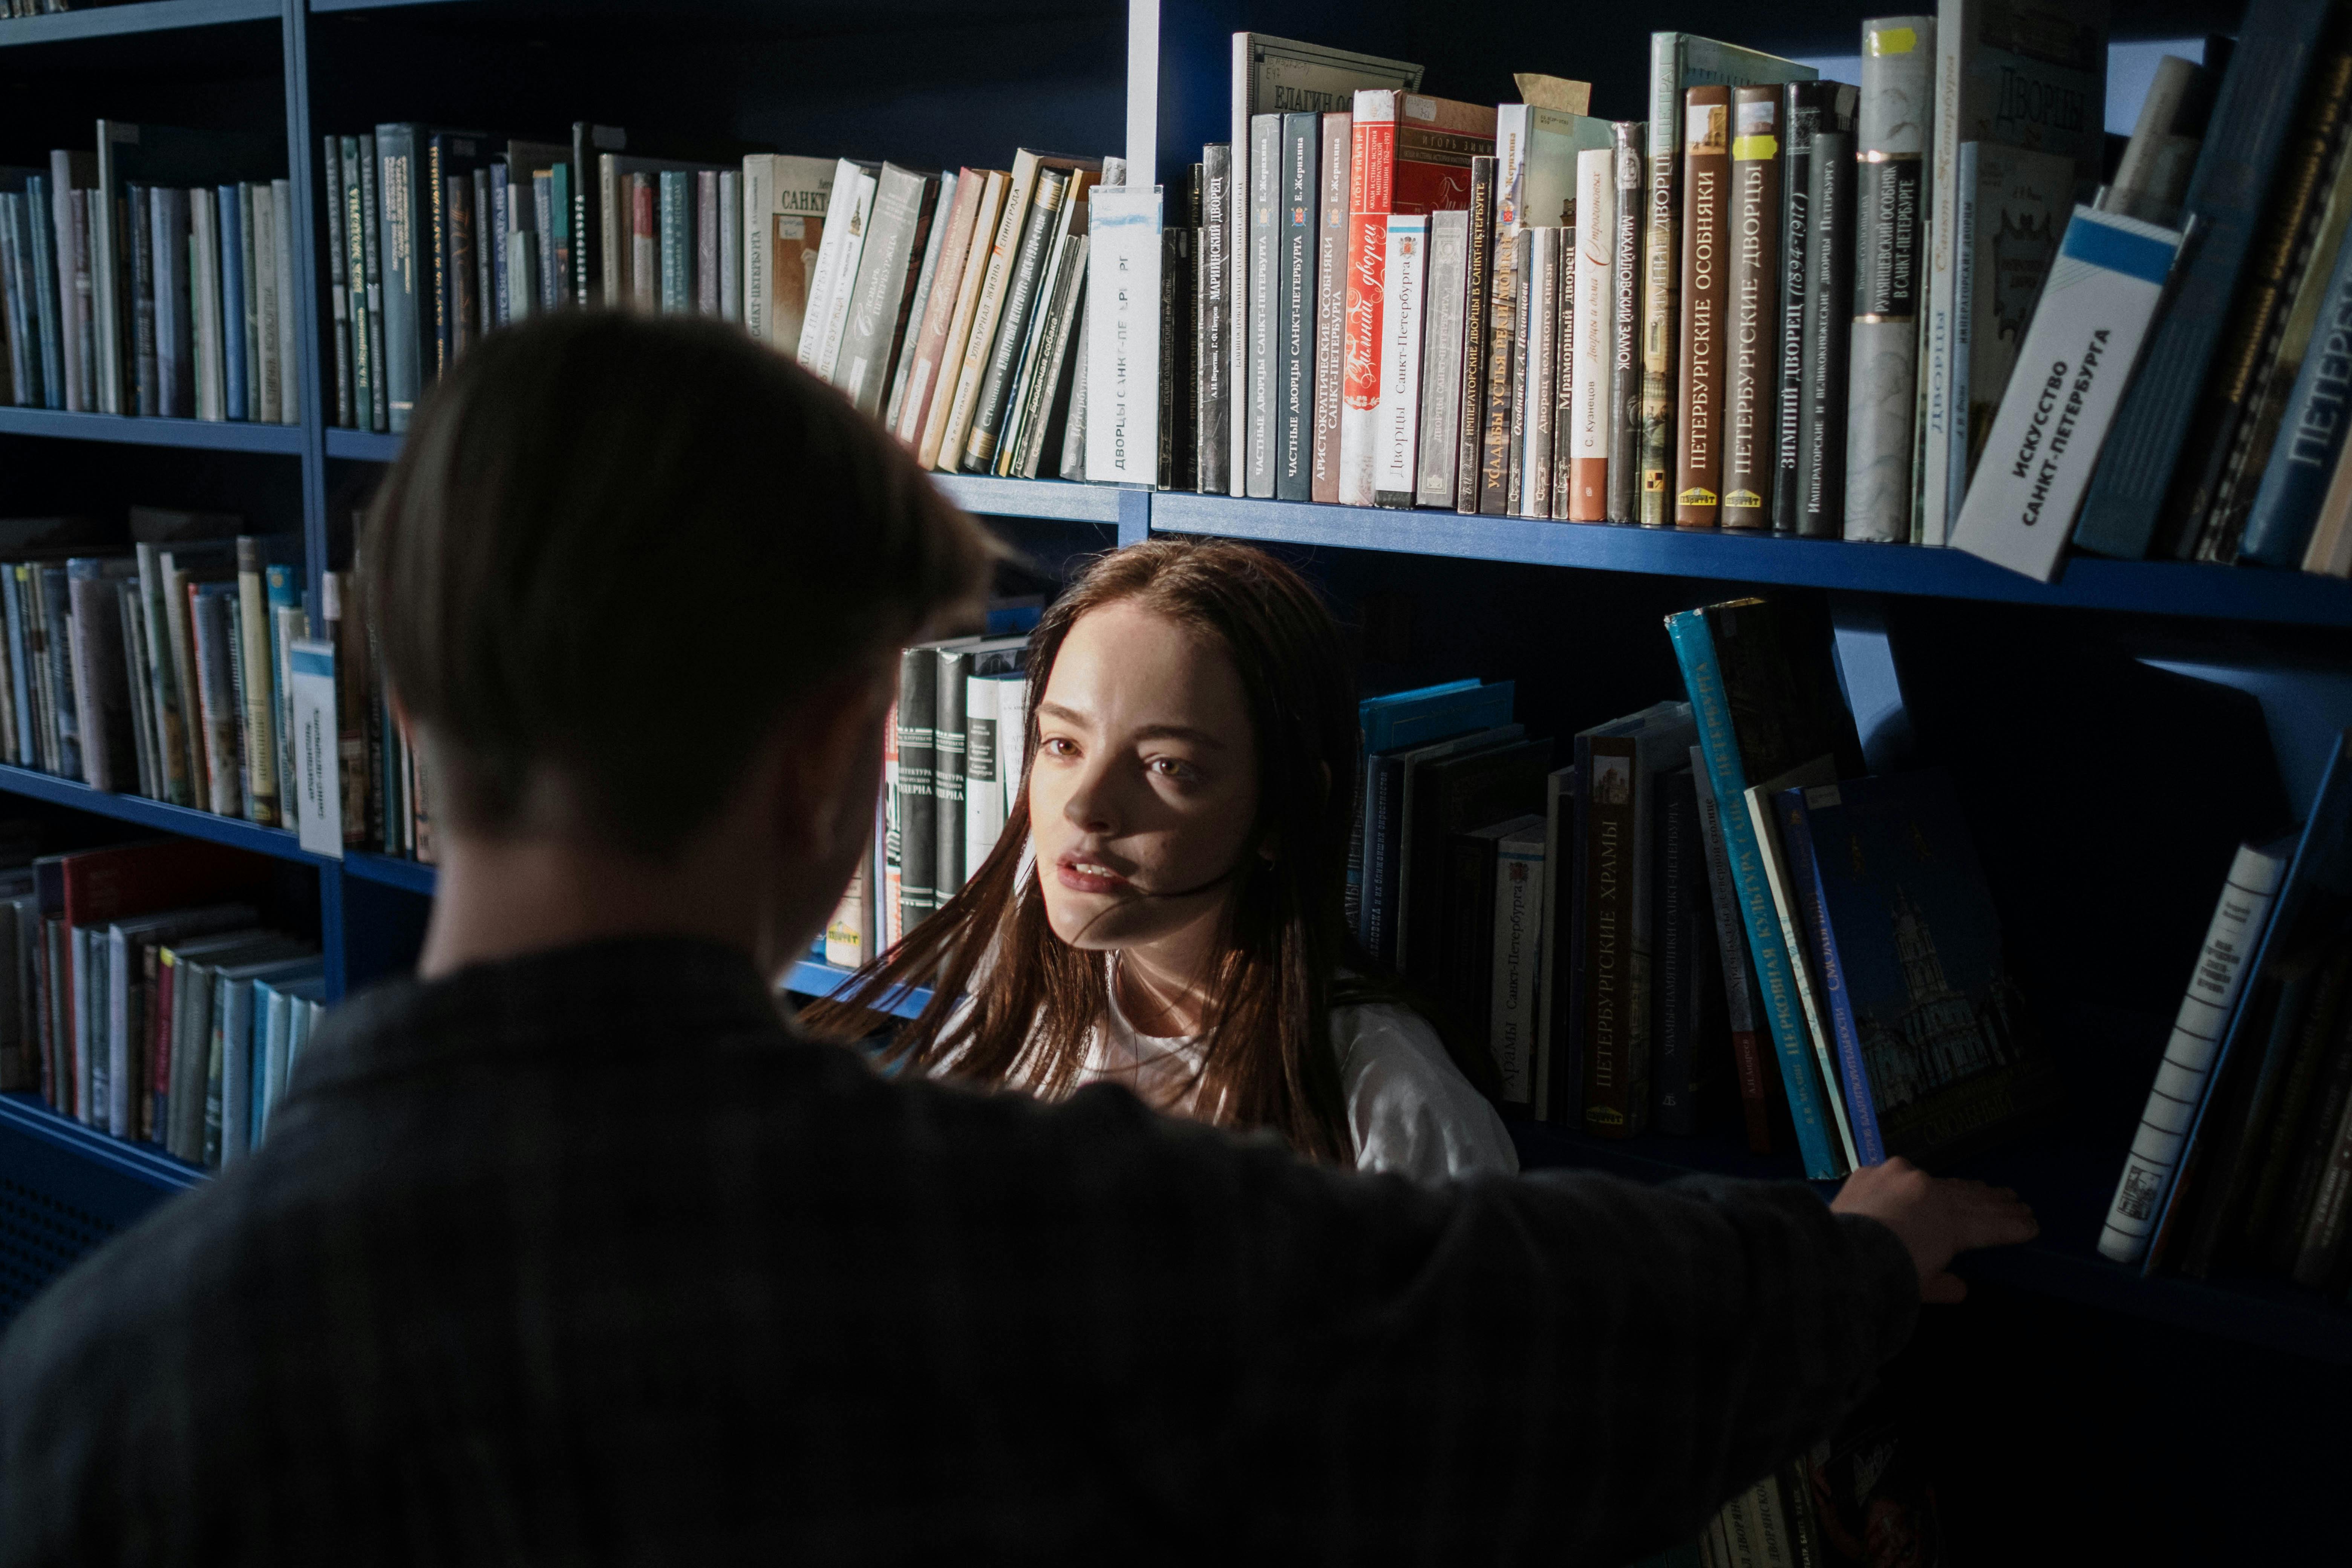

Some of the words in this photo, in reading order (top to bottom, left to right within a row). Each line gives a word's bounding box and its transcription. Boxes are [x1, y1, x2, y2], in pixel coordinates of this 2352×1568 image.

[1275, 85, 1333, 112] ЕЛАГИН
[1998, 65, 2084, 133] ДВОРЦЫ
[1258, 138, 1269, 190] Жерихина
[1294, 137, 1305, 190] Жерихина
[1330, 138, 1341, 190] Жерихина
[1423, 135, 1456, 149] ИГОРЬ
[1210, 178, 1223, 222] ДВОРЕЦ
[1259, 192, 1267, 202] Е.
[1294, 191, 1304, 201] Е.
[1331, 192, 1340, 202] Е.
[1652, 142, 1673, 232] ДВОРЦЫ
[1741, 165, 1764, 268] ДВОРЦЫ
[1879, 166, 1897, 220] ОСОБНЯК
[1208, 225, 1222, 300] МАРИИНСКИЙ
[1471, 182, 1485, 286] САНКТ-ПЕТЕРБУРГЕ
[1694, 171, 1715, 291] ОСОБНЯКИ
[1787, 191, 1808, 296] (1894-1917)
[1893, 179, 1914, 289] САНКТ-ПЕТЕРБУРГЕ
[984, 263, 1002, 300] ЖИЗНЬ
[1257, 235, 1268, 355] САНКТ-ПЕТЕРБУРГА
[1290, 235, 1303, 355] САНКТ-ПЕТЕРБУРГА
[1321, 237, 1333, 318] ОСОБНЯКИ
[1543, 264, 1553, 305] князя
[1563, 247, 1576, 302] дворец
[1618, 215, 1635, 323] МИХАЙЛОВСКИЙ
[1874, 222, 1893, 312] РУМЯНЦЕВСКИЙ
[1893, 290, 1909, 298] В
[996, 325, 1018, 371] КУЛЬТУРНЫЙ
[1395, 261, 1413, 394] Санкт-Петербурга
[1468, 299, 1481, 345] ДВОРЦЫ
[1494, 306, 1508, 350] РЕКИ
[1517, 282, 1530, 349] Половцова
[1540, 311, 1553, 375] великого
[1617, 326, 1631, 370] ЗАМОК
[1785, 303, 1804, 381] ДВОРЕЦ
[1256, 358, 1268, 412] ДВОРЦЫ
[1288, 358, 1301, 413] ДВОРЦЫ
[1328, 290, 1341, 429] САНКТ-ПЕТЕРБУРГА
[1465, 346, 1478, 436] ИМПЕРАТОРСКИЕ
[1491, 355, 1506, 407] УСТЬЯ
[1516, 352, 1527, 365] А.
[1516, 369, 1525, 380] А.
[1559, 309, 1574, 410] Мраморный
[1689, 299, 1712, 470] ПЕТЕРБУРГСКИЕ
[1734, 279, 1760, 476] ПЕТЕРБУРГСКИЕ
[1931, 310, 1945, 435] ДВОРЦЫ
[1315, 322, 1332, 481] АРИСТОКРАТИЧЕСКИЕ
[1513, 383, 1524, 436] Особняк
[1537, 381, 1551, 435] Дворец
[1586, 381, 1596, 434] Кузнецов
[1780, 387, 1800, 469] ЗИМНИЙ
[2012, 361, 2068, 479] ИСКУССТВО
[2022, 329, 2111, 527] САНКТ-ПЕТЕРБУРГА
[1114, 403, 1127, 471] ДВОРЦЫ
[1254, 415, 1266, 475] ЧАСТНЫЕ
[1287, 417, 1299, 477] ЧАСТНЫЕ
[1389, 406, 1407, 478] Дворцы
[1486, 412, 1504, 489] УСАДЬБЫ
[1585, 436, 1594, 447] С.
[899, 784, 932, 796] ОДЕРНА
[1599, 821, 1618, 900] ХРАМЫ
[1666, 800, 1679, 925] САНКТ-ПЕТЕРБУРГА
[1737, 852, 1772, 940] КУЛЬТУРА
[1369, 908, 1381, 960] АВЛОВСКА
[1505, 884, 1524, 1010] Санкт-Петербурга
[1594, 910, 1615, 1087] ПЕТЕРБУРГСКИЕ
[1761, 948, 1800, 1057] ЦЕРКОВНАЯ
[1502, 1022, 1519, 1086] Храмы
